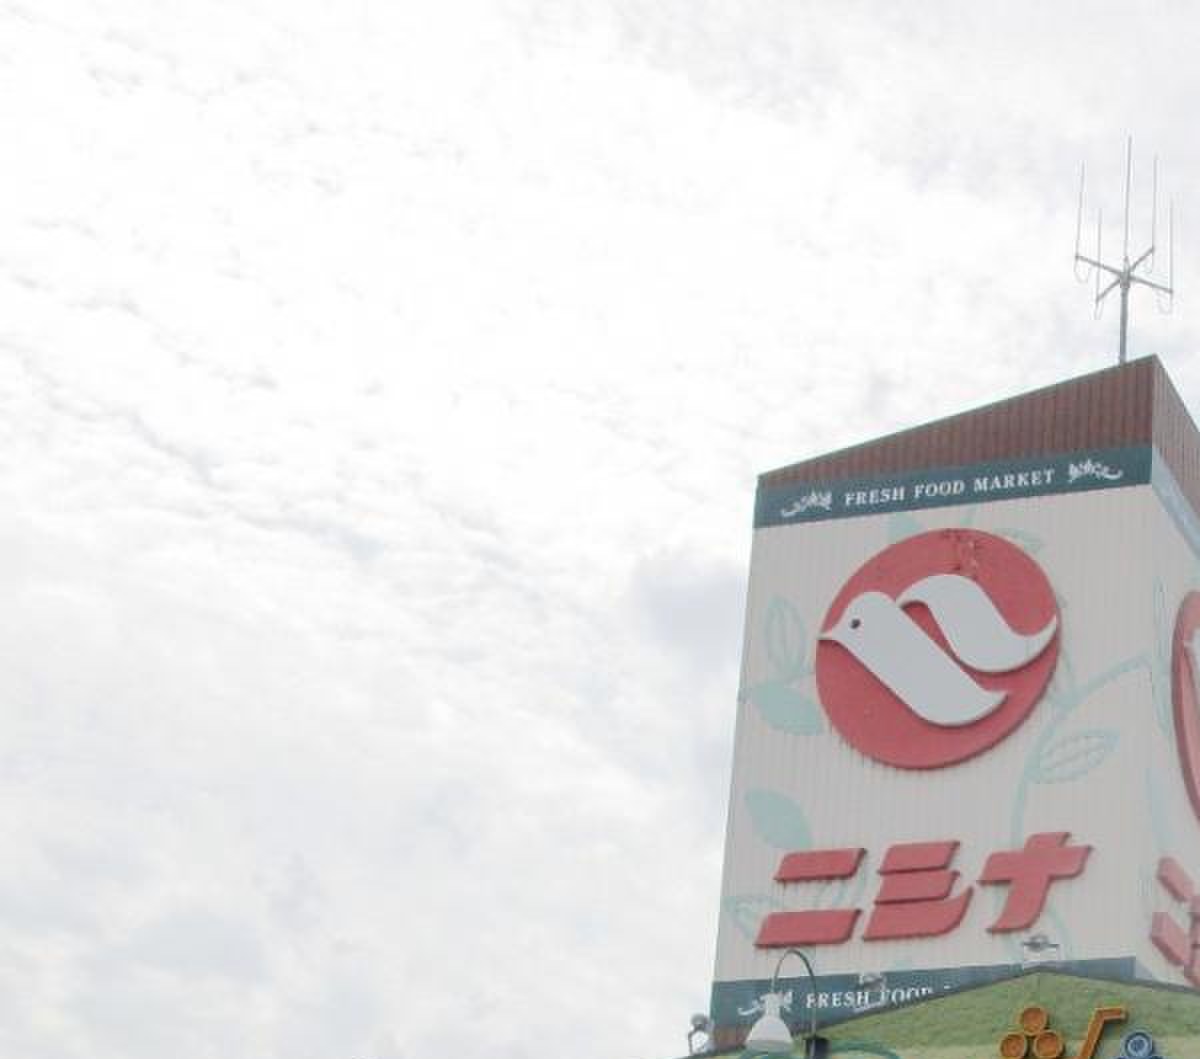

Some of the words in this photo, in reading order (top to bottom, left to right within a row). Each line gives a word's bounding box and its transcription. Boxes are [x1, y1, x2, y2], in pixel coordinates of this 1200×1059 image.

[844, 487, 905, 506] FRESH
[914, 480, 965, 498] FOOD
[974, 469, 1055, 492] MARKET
[754, 832, 1094, 948] ニシナ
[806, 991, 869, 1008] FRESH
